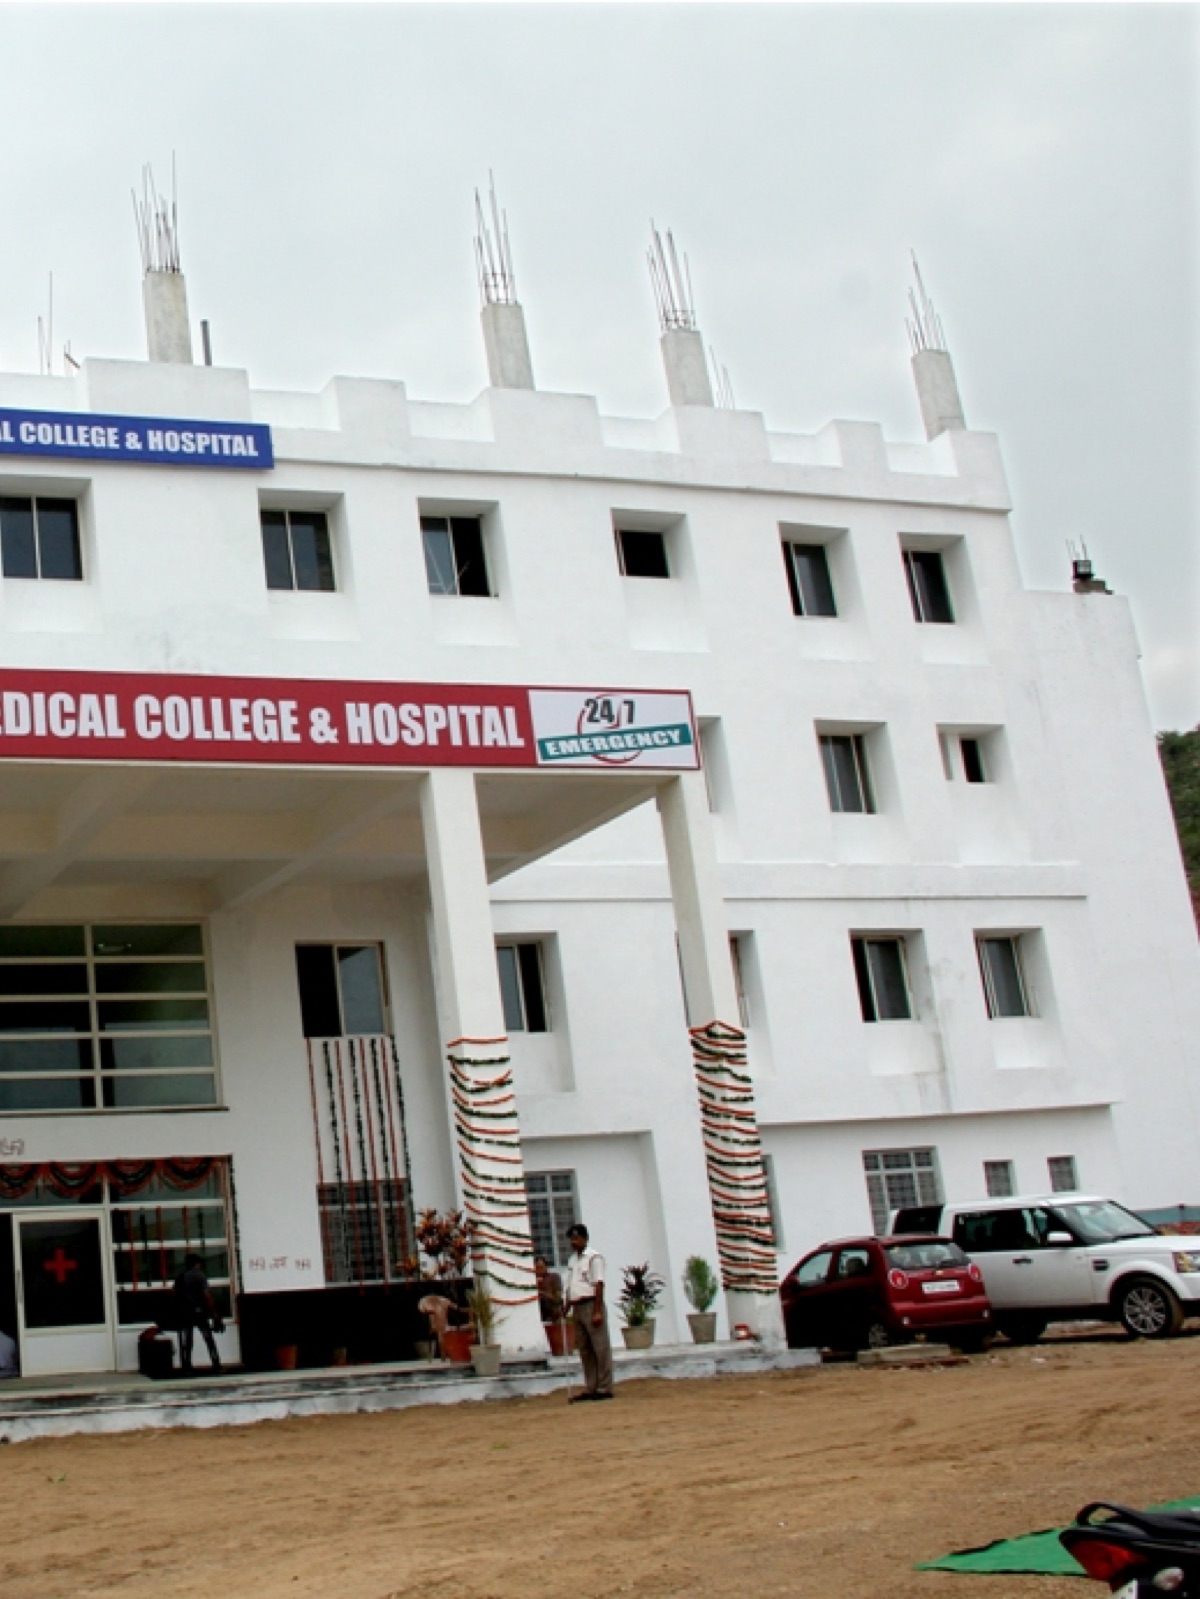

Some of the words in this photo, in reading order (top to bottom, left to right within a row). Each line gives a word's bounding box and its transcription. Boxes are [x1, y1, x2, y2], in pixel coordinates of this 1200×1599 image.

[20, 422, 120, 450] COLLEGE
[125, 430, 144, 450] &
[148, 429, 259, 457] HOSPITAL
[134, 694, 302, 743] COLLEGE
[309, 707, 339, 744] &
[345, 702, 525, 747] HOSPITAL
[544, 728, 681, 757] EMERGENCY
